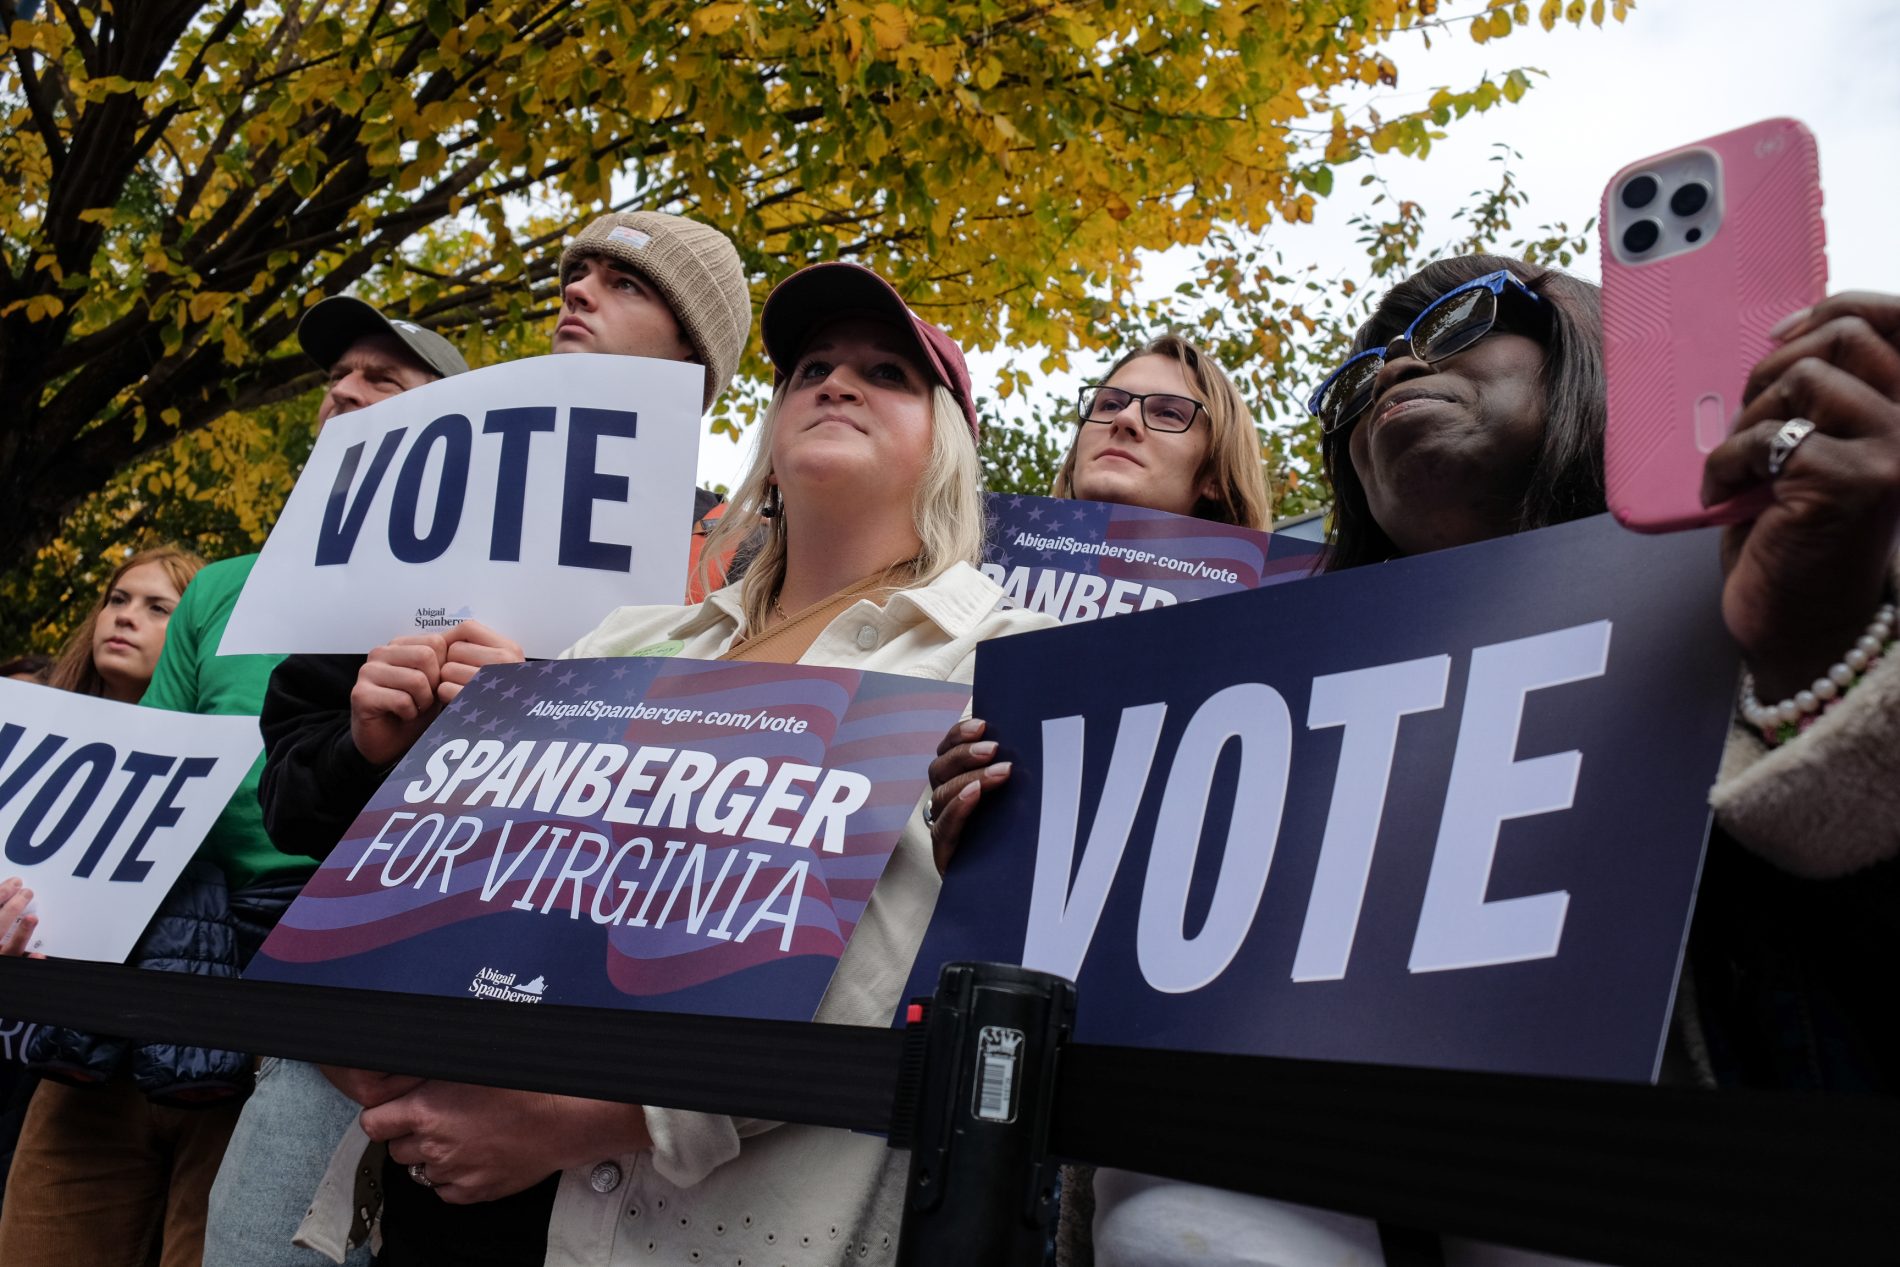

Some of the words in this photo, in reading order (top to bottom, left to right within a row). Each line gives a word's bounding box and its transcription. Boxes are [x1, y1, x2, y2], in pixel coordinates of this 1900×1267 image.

[315, 406, 638, 573] VOTE
[1014, 532, 1238, 585] AbigailSpanberger.com/vote
[414, 617, 464, 629] Spanber
[415, 608, 446, 617] Abigail
[526, 700, 808, 735] AbigailSpanberger.com/vote
[404, 738, 871, 855] SPANBERGER
[1021, 619, 1612, 993] VOTE
[346, 811, 483, 894] FOR
[479, 819, 810, 953] VIRGINIA
[475, 966, 517, 986] Abigail
